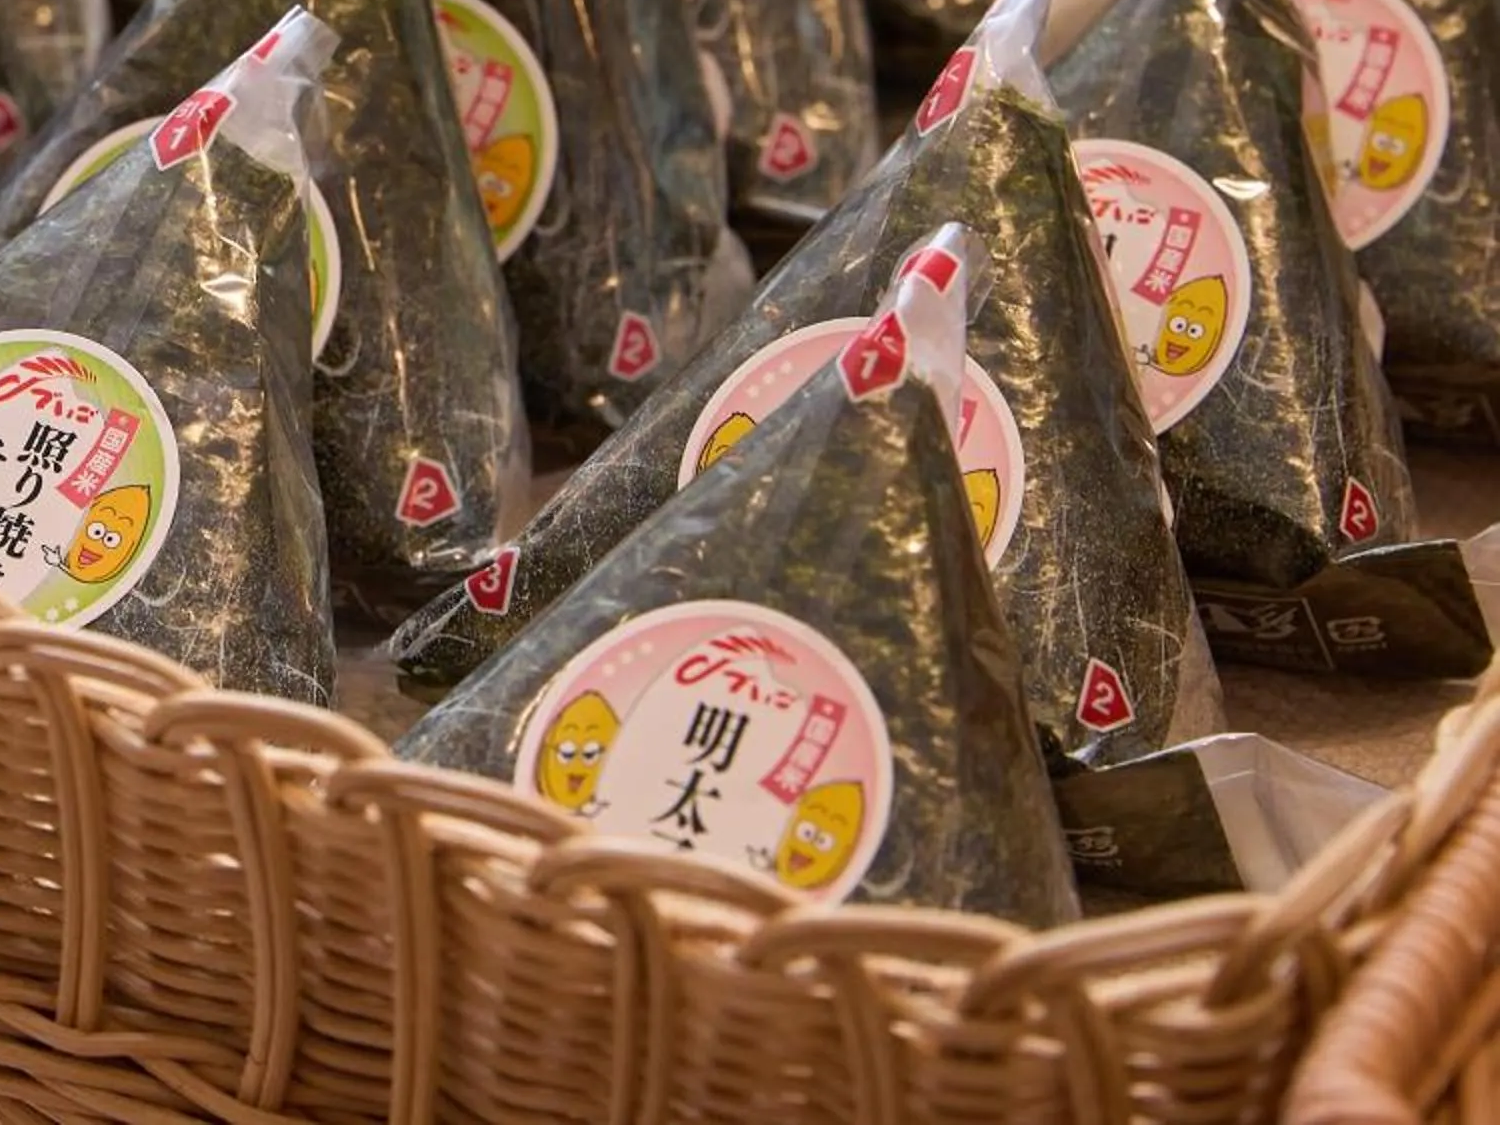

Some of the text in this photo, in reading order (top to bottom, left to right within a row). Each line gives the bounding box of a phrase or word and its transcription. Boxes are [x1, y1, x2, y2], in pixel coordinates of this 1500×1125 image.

[169, 125, 188, 150] 1
[624, 331, 645, 365] 2
[860, 350, 879, 380] 1
[412, 477, 439, 509] 2
[1350, 499, 1367, 531] 2
[480, 563, 501, 592] 3
[1091, 682, 1115, 715] 2
[650, 702, 751, 850] 明太
